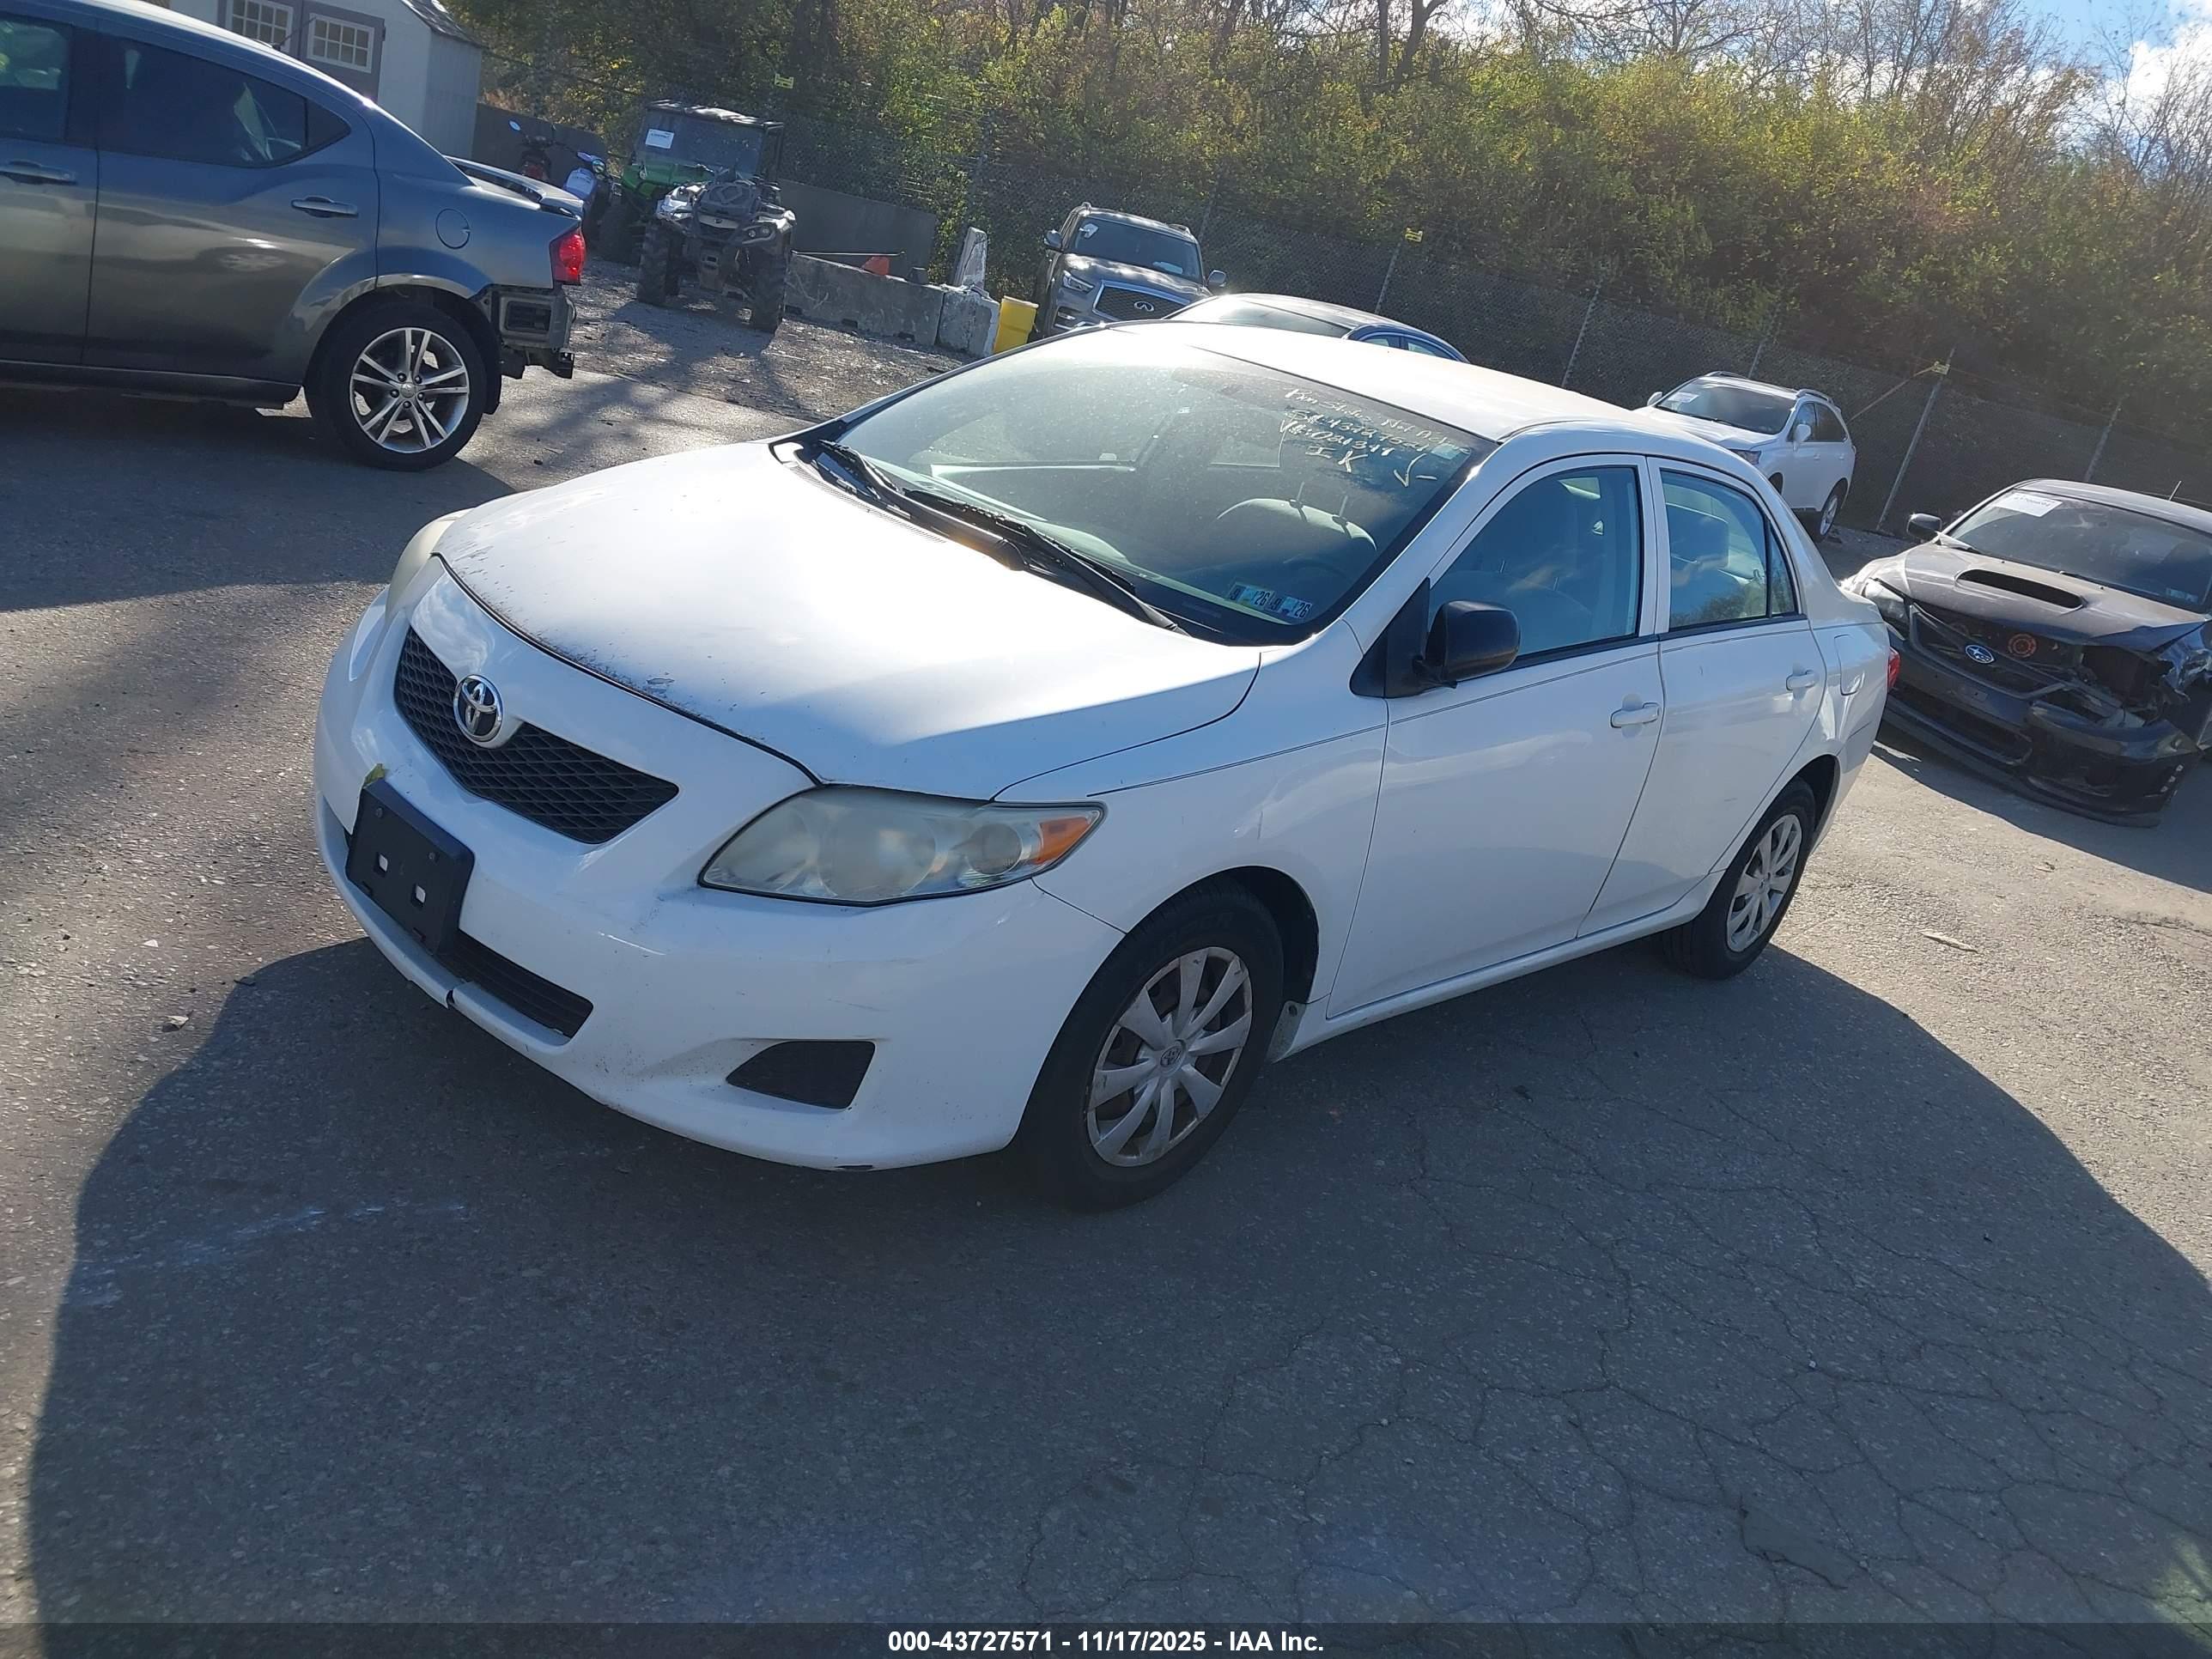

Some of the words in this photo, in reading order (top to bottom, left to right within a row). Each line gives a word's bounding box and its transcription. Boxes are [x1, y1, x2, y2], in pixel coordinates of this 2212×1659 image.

[1380, 418, 1415, 432] Not
[1254, 591, 1270, 606] 26
[1294, 603, 1311, 618] 26
